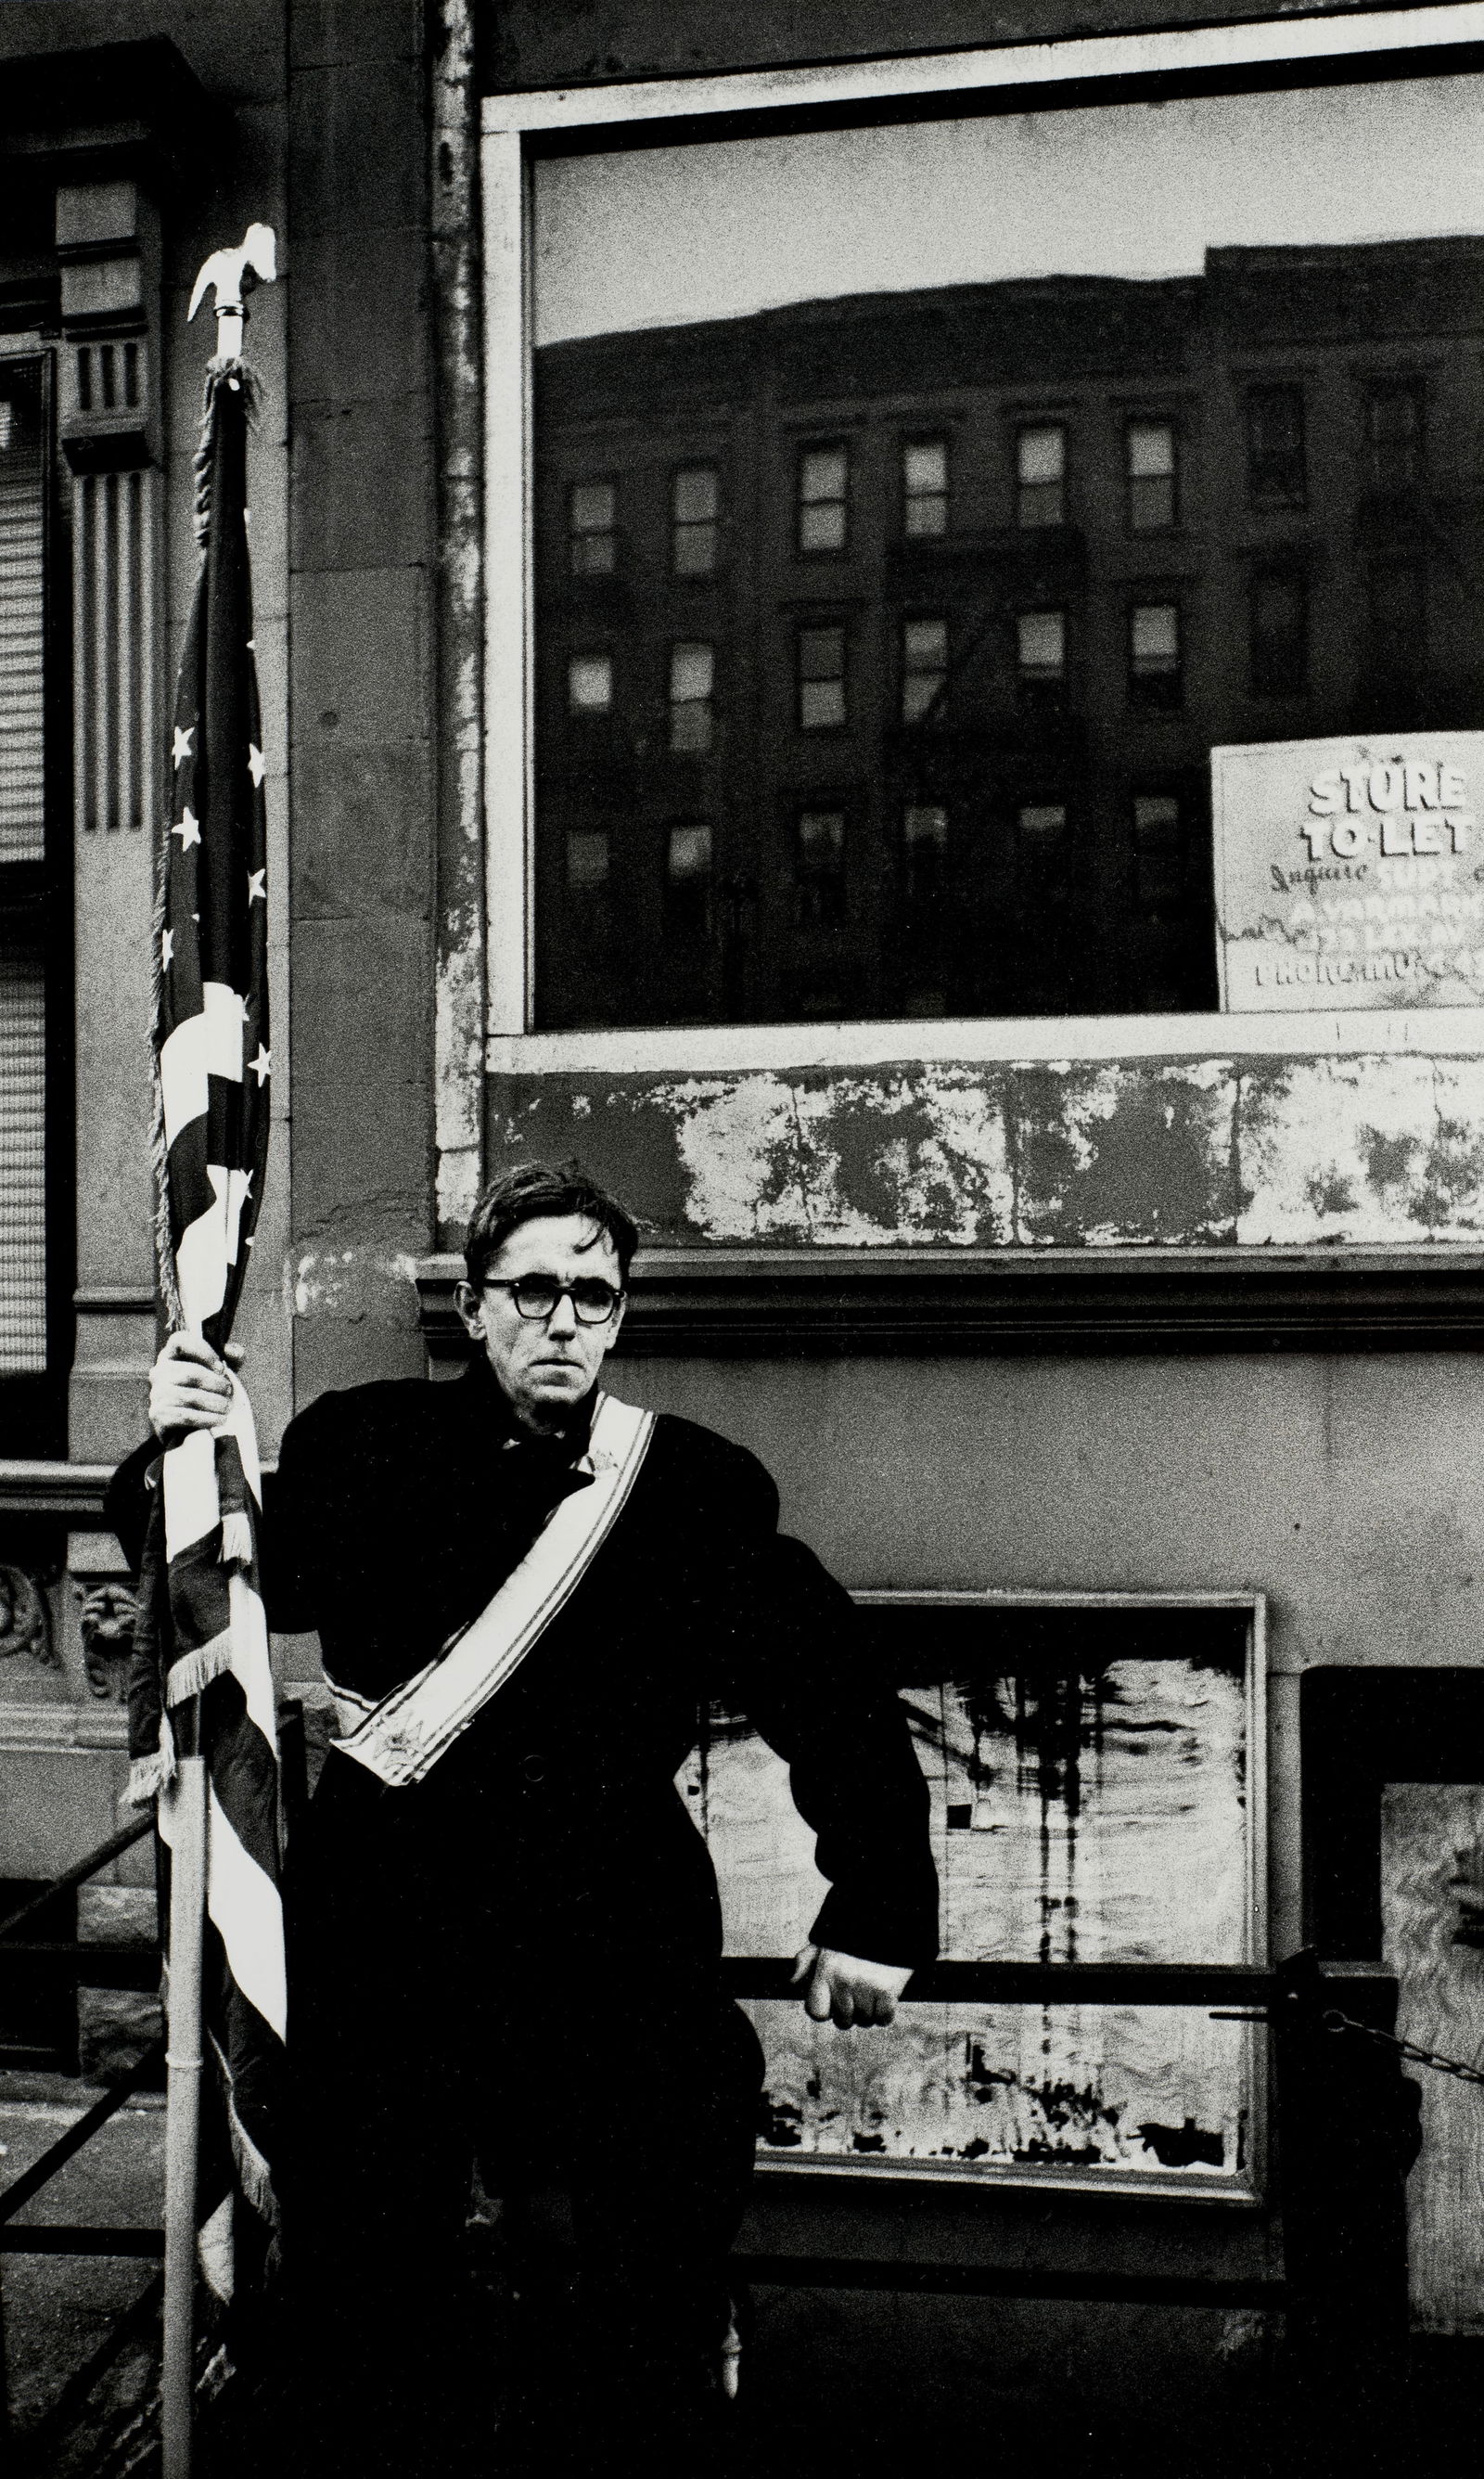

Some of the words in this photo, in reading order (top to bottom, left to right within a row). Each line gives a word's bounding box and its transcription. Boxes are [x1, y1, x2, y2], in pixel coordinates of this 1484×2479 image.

[1308, 762, 1467, 817] STORE
[1298, 819, 1368, 862] TO
[1378, 815, 1477, 858] LET
